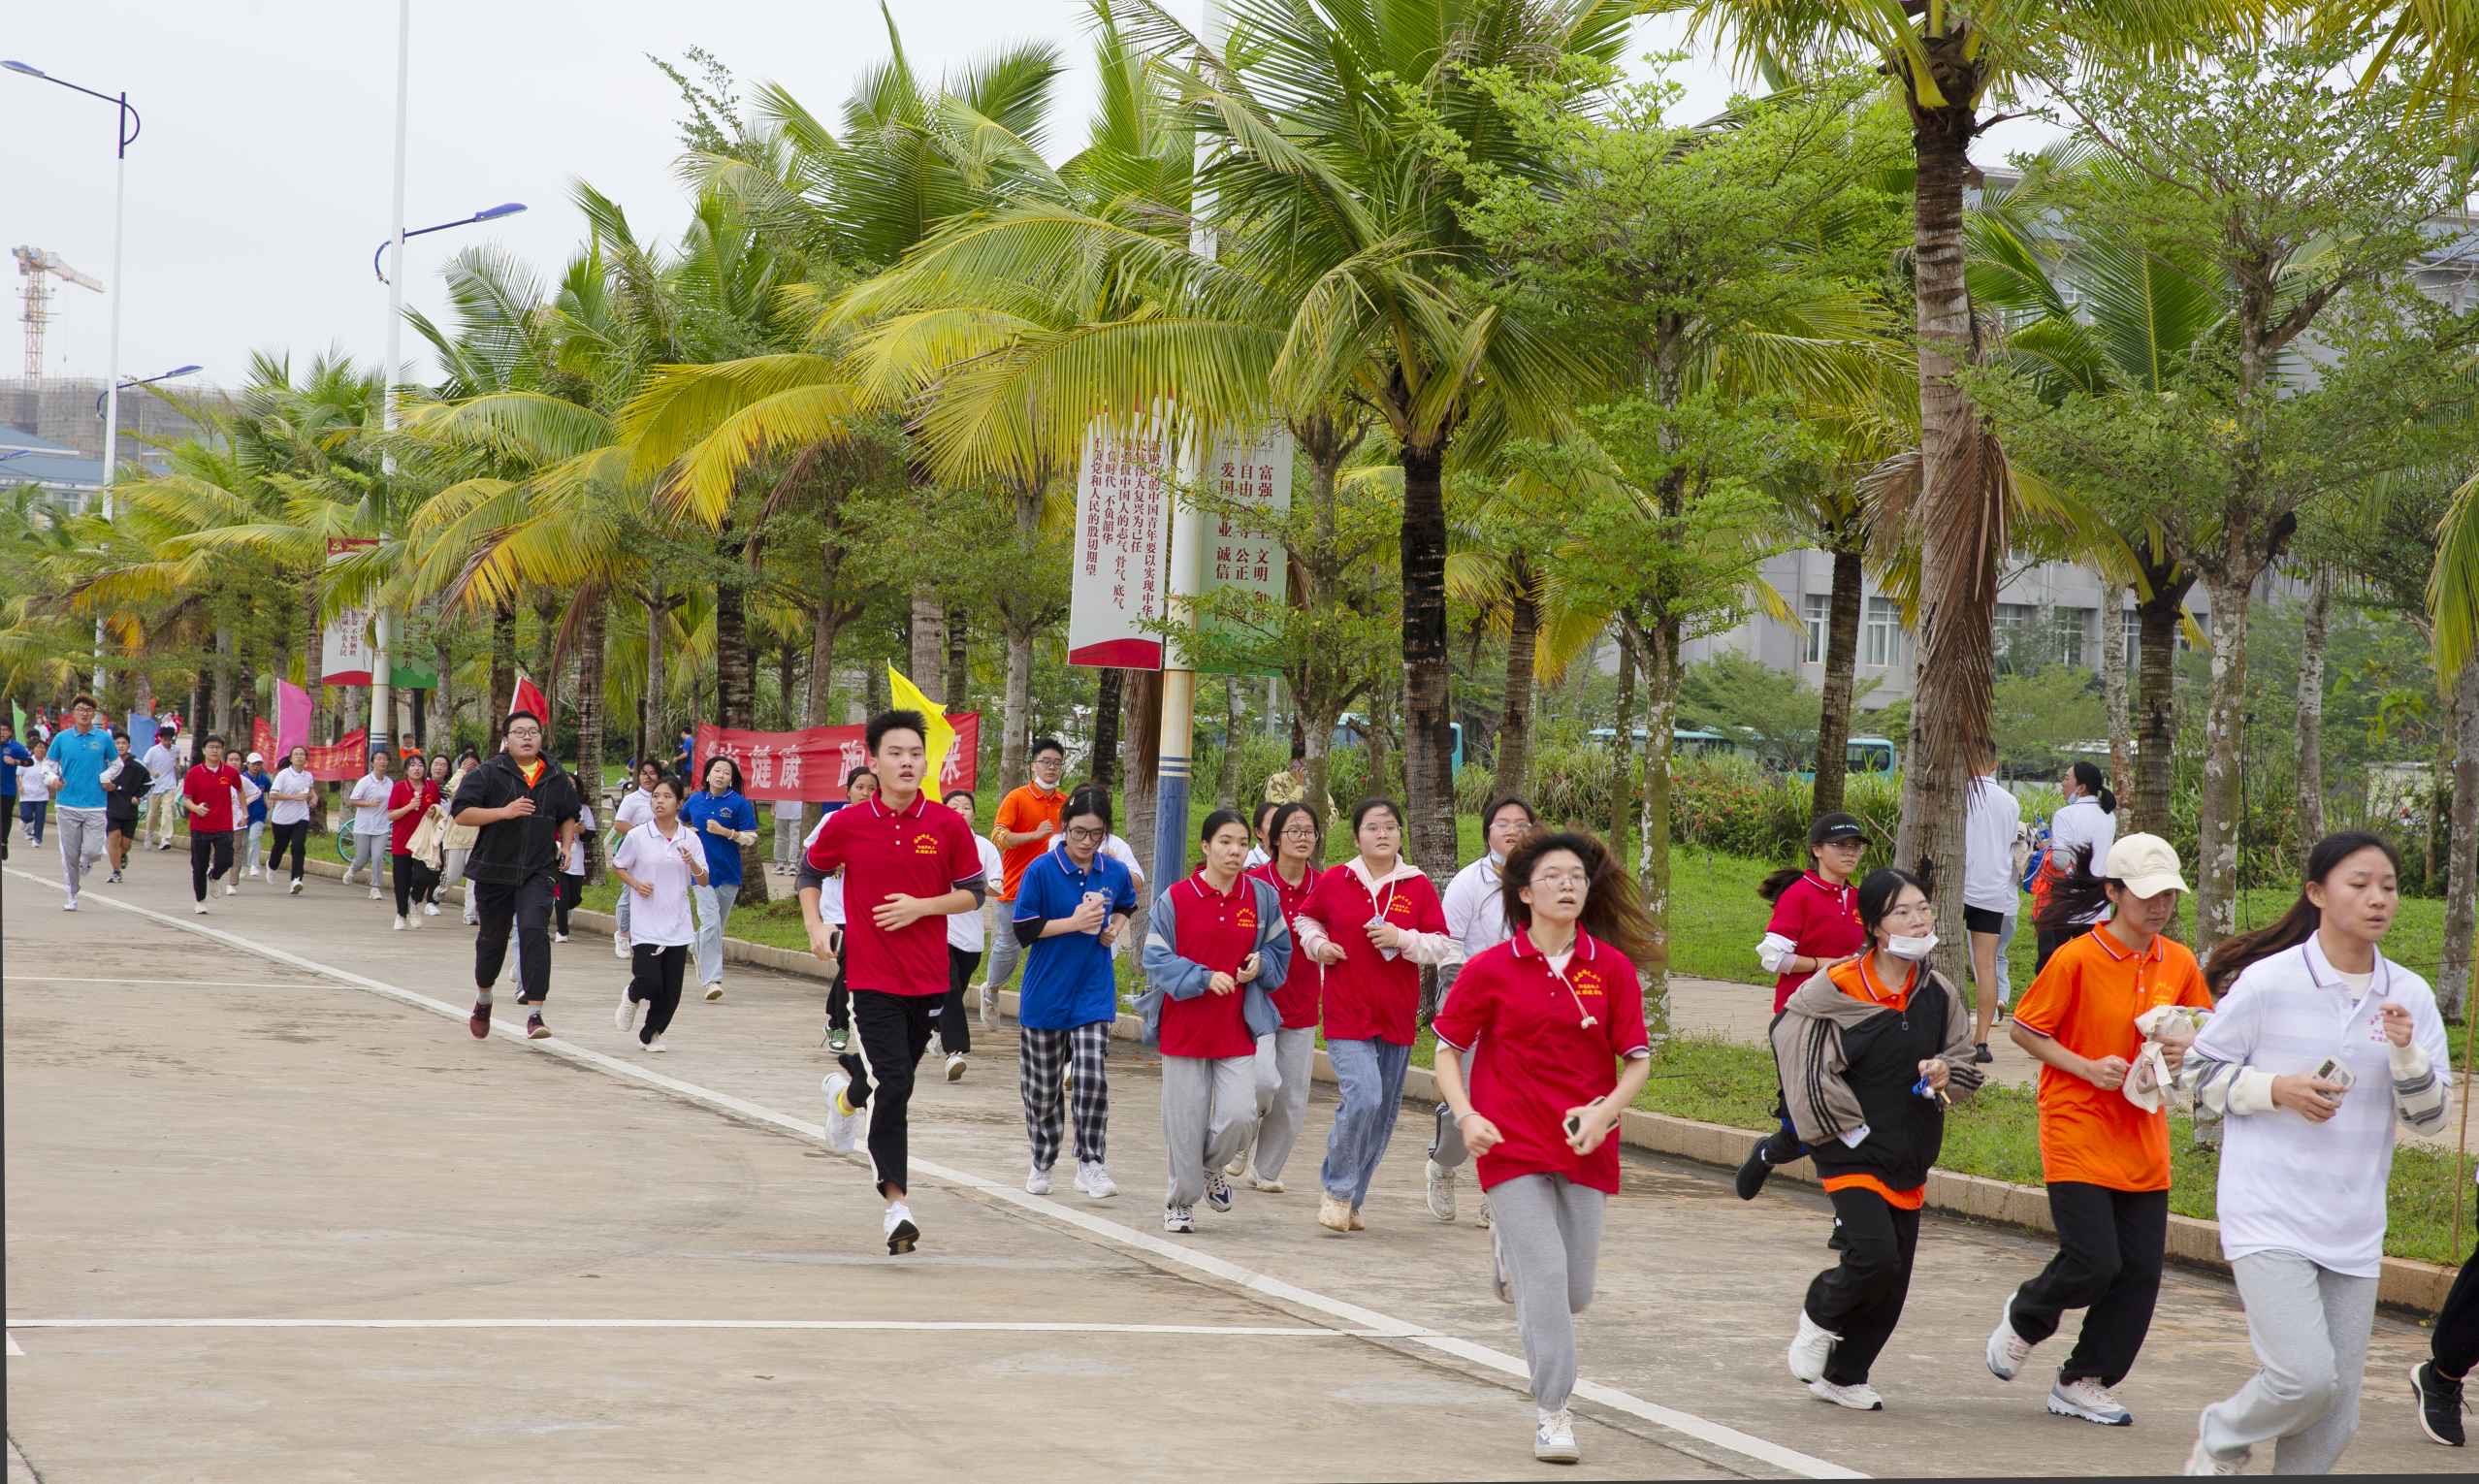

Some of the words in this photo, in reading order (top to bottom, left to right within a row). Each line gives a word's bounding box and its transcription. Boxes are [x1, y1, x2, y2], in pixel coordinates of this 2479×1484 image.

[1131, 438, 1147, 553] 伟大复兴为己任
[1258, 464, 1273, 498] 富强
[1216, 546, 1232, 580] 诚信
[1237, 547, 1250, 581] 公正
[1254, 548, 1270, 582] 文明
